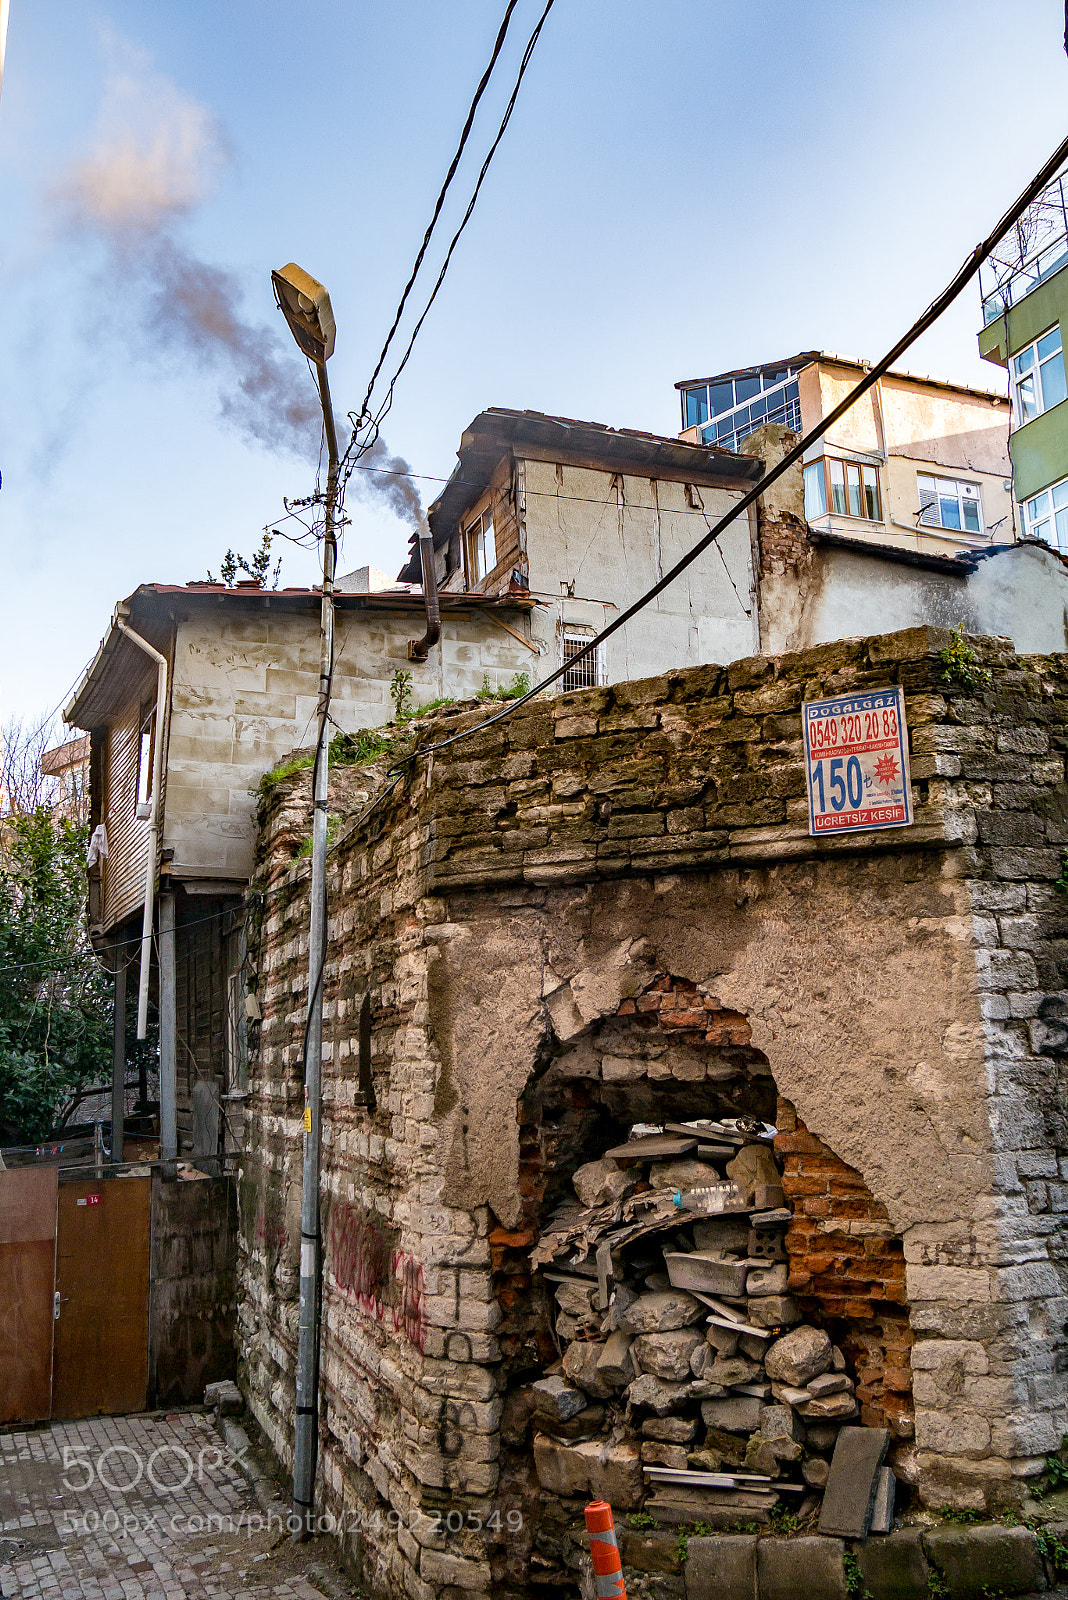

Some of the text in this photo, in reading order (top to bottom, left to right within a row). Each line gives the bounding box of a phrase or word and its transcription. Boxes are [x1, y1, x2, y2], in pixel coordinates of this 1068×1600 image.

[809, 696, 894, 718] DOĞALGAZ
[809, 709, 898, 748] 0549 320 20 83
[812, 755, 863, 813] 150
[816, 808, 902, 827] ÜCRETSİZ KEŞİF
[90, 1196, 98, 1204] 14
